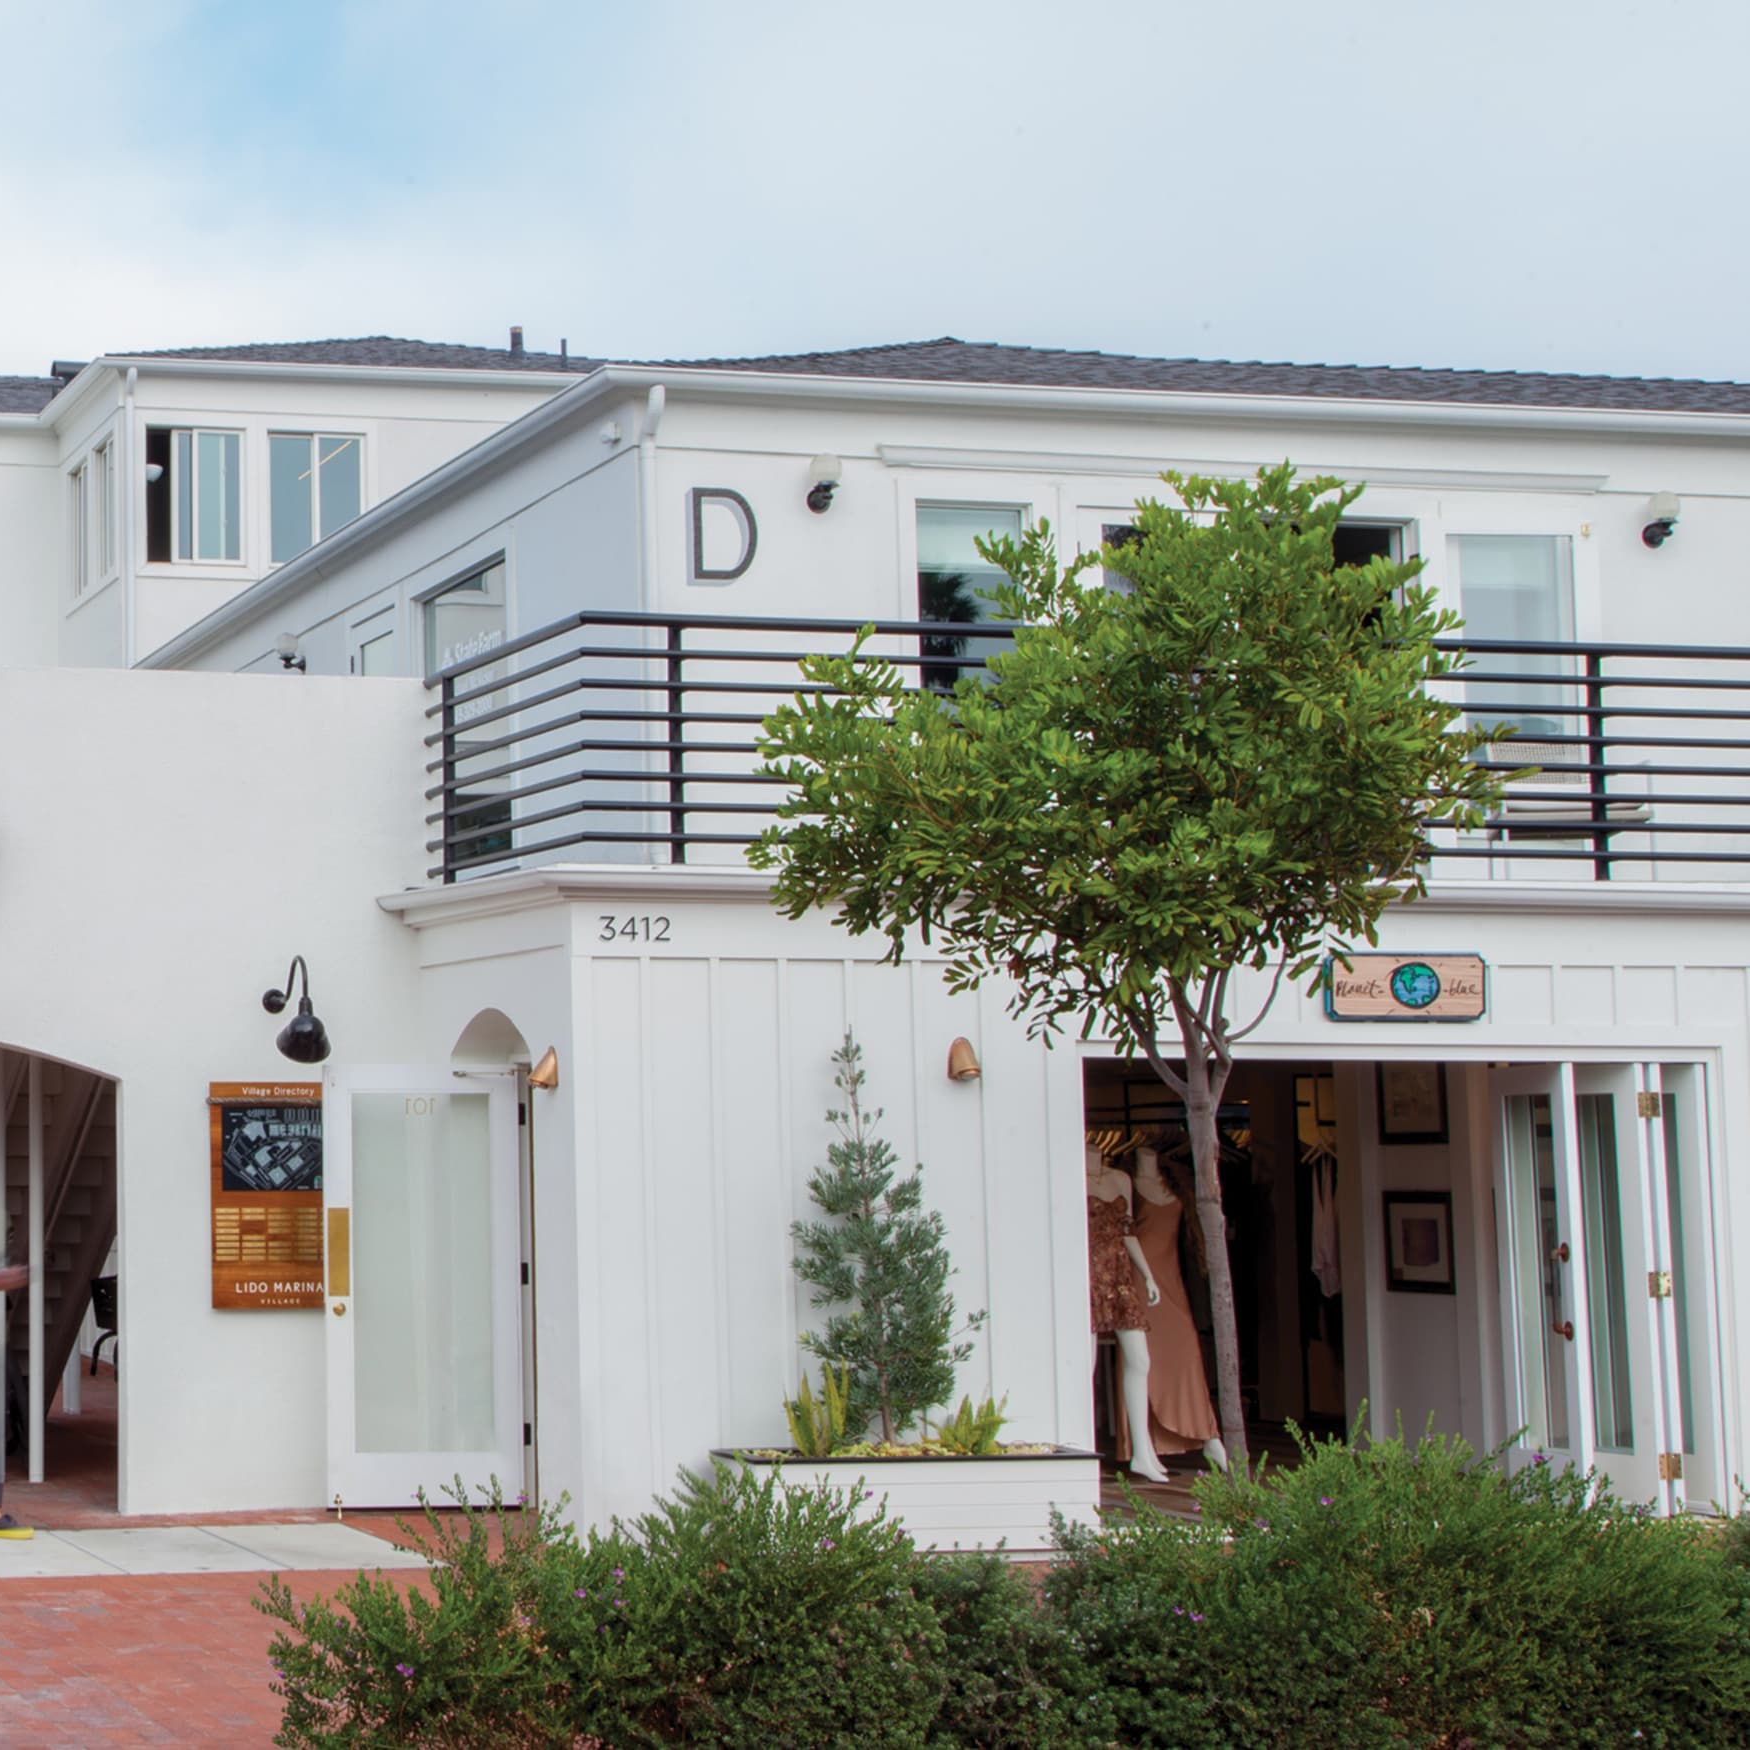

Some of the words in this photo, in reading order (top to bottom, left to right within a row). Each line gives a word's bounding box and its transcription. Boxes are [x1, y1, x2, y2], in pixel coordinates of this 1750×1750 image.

[690, 486, 758, 581] D
[599, 916, 671, 941] 3412
[242, 1087, 271, 1096] Village
[274, 1087, 315, 1097] Directory
[235, 1281, 268, 1294] LIDO
[273, 1281, 324, 1294] MARINA
